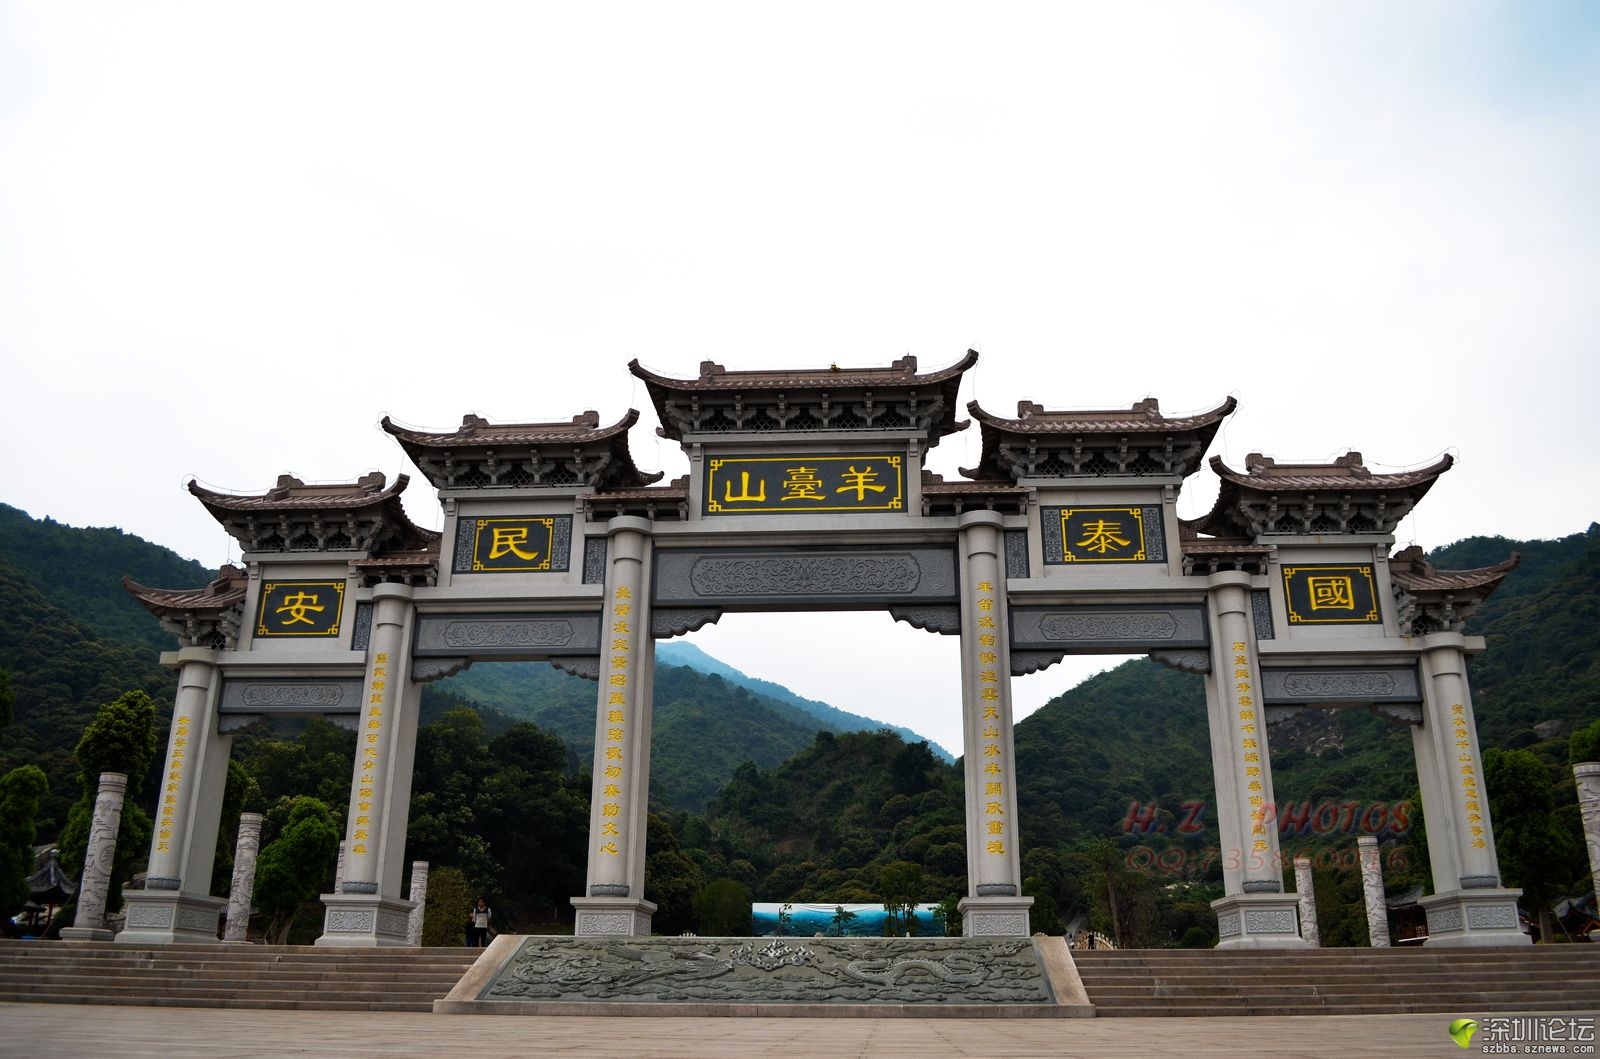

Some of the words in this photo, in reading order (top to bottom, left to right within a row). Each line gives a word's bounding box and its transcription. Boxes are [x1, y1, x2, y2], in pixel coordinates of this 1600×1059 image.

[489, 527, 539, 560] 民
[1076, 519, 1131, 554] 泰
[276, 591, 325, 625] 安
[1308, 576, 1355, 611] 國
